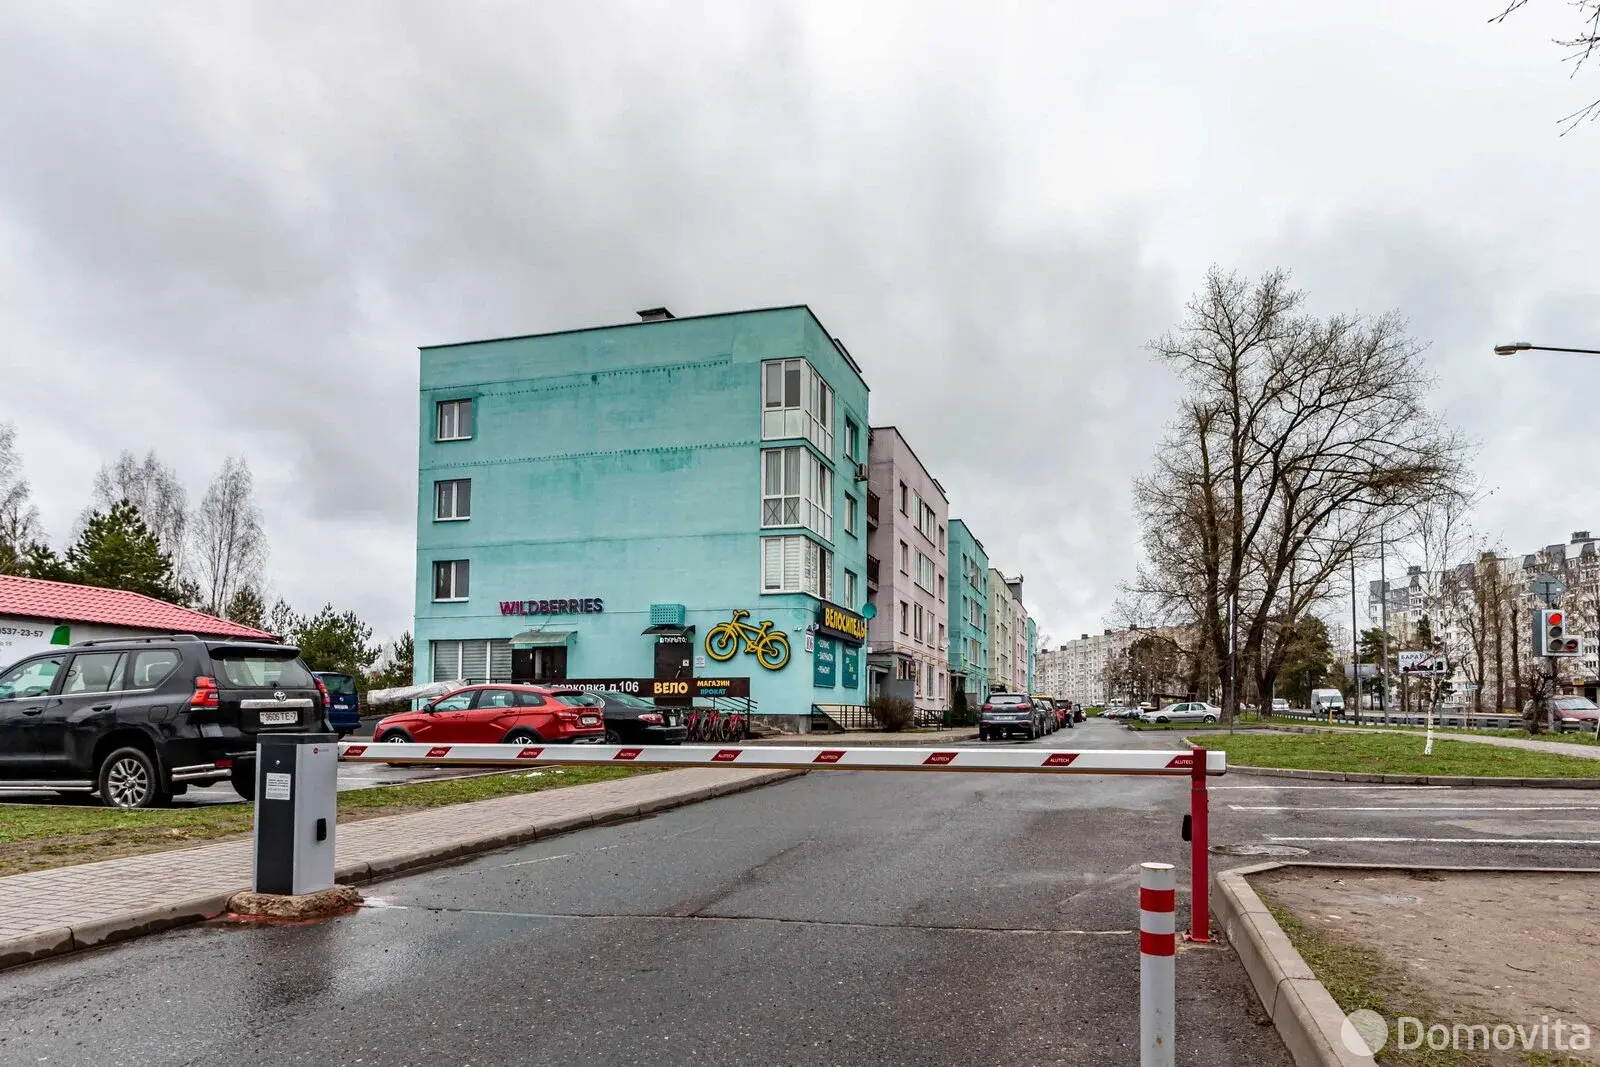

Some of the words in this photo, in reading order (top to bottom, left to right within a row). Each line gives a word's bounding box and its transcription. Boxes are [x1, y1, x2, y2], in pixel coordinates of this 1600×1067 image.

[500, 598, 603, 616] WILDBERRIES
[825, 607, 866, 640] ВЕЛОСИПЕДЫ
[0, 627, 44, 637] 537-23-57
[553, 683, 605, 692] рковка
[609, 681, 639, 693] д.106
[653, 682, 689, 694] ВЕЛО
